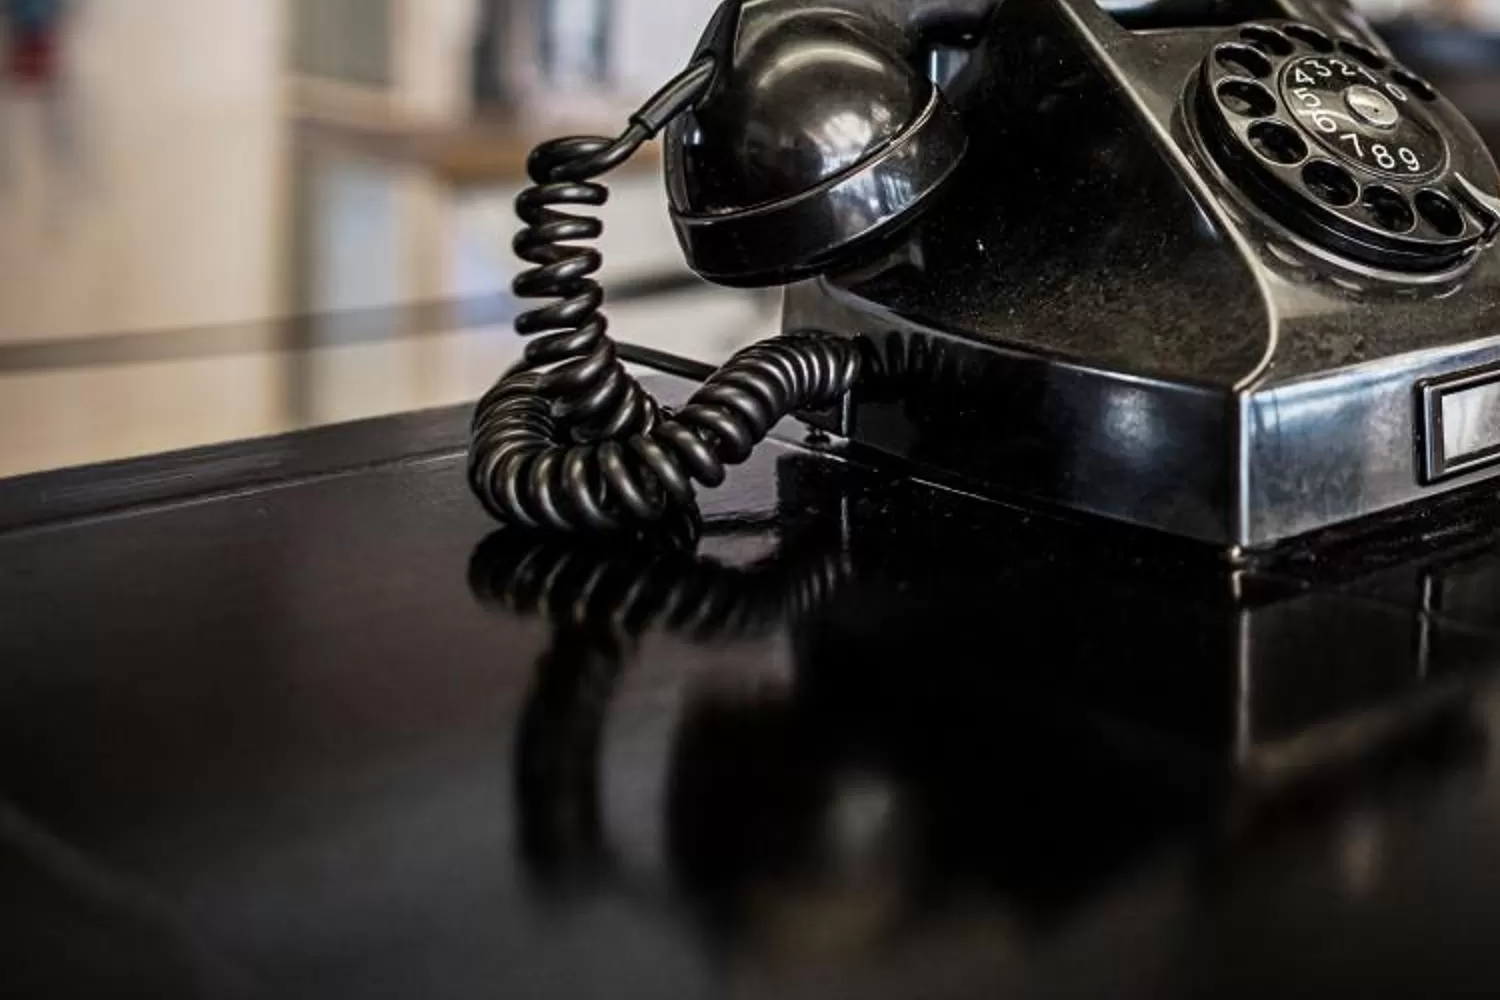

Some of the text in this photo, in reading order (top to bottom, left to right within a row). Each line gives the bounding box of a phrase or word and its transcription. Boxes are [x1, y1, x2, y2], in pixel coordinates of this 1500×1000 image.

[1295, 67, 1316, 85] 4
[1304, 60, 1332, 77] 3
[1328, 59, 1357, 76] 2
[1357, 66, 1378, 84] 1
[1292, 87, 1321, 107] 5
[1384, 83, 1408, 102] 0
[1311, 111, 1337, 133] 6
[1340, 133, 1364, 157] 7
[1371, 144, 1395, 169] 8
[1398, 147, 1420, 171] 9
